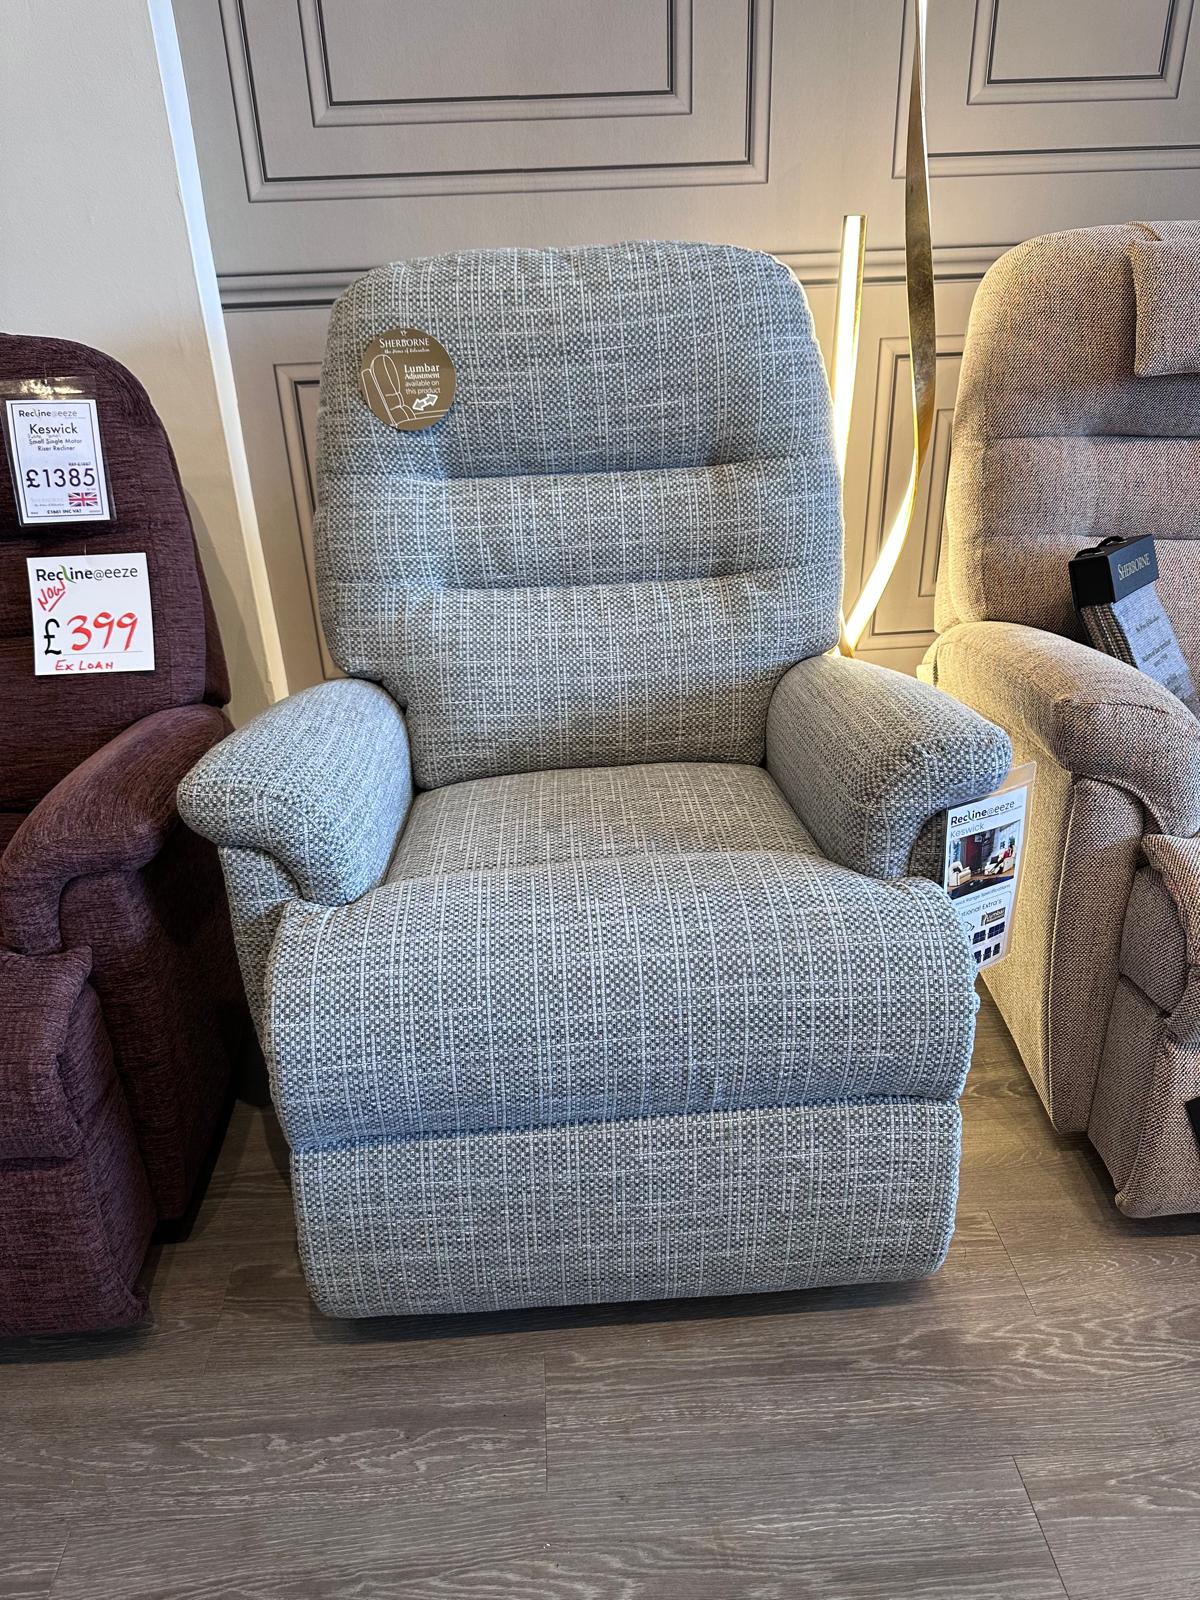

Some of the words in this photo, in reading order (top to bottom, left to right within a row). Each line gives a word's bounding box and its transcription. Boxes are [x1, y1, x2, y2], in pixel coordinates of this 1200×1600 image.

[379, 337, 430, 348] SHERBORNE
[404, 362, 440, 373] Lumbar
[404, 372, 440, 380] Adjustment
[417, 387, 441, 395] product
[29, 422, 78, 434] Keswick
[26, 467, 95, 488] £1385
[1117, 553, 1150, 580] SHERBORNE
